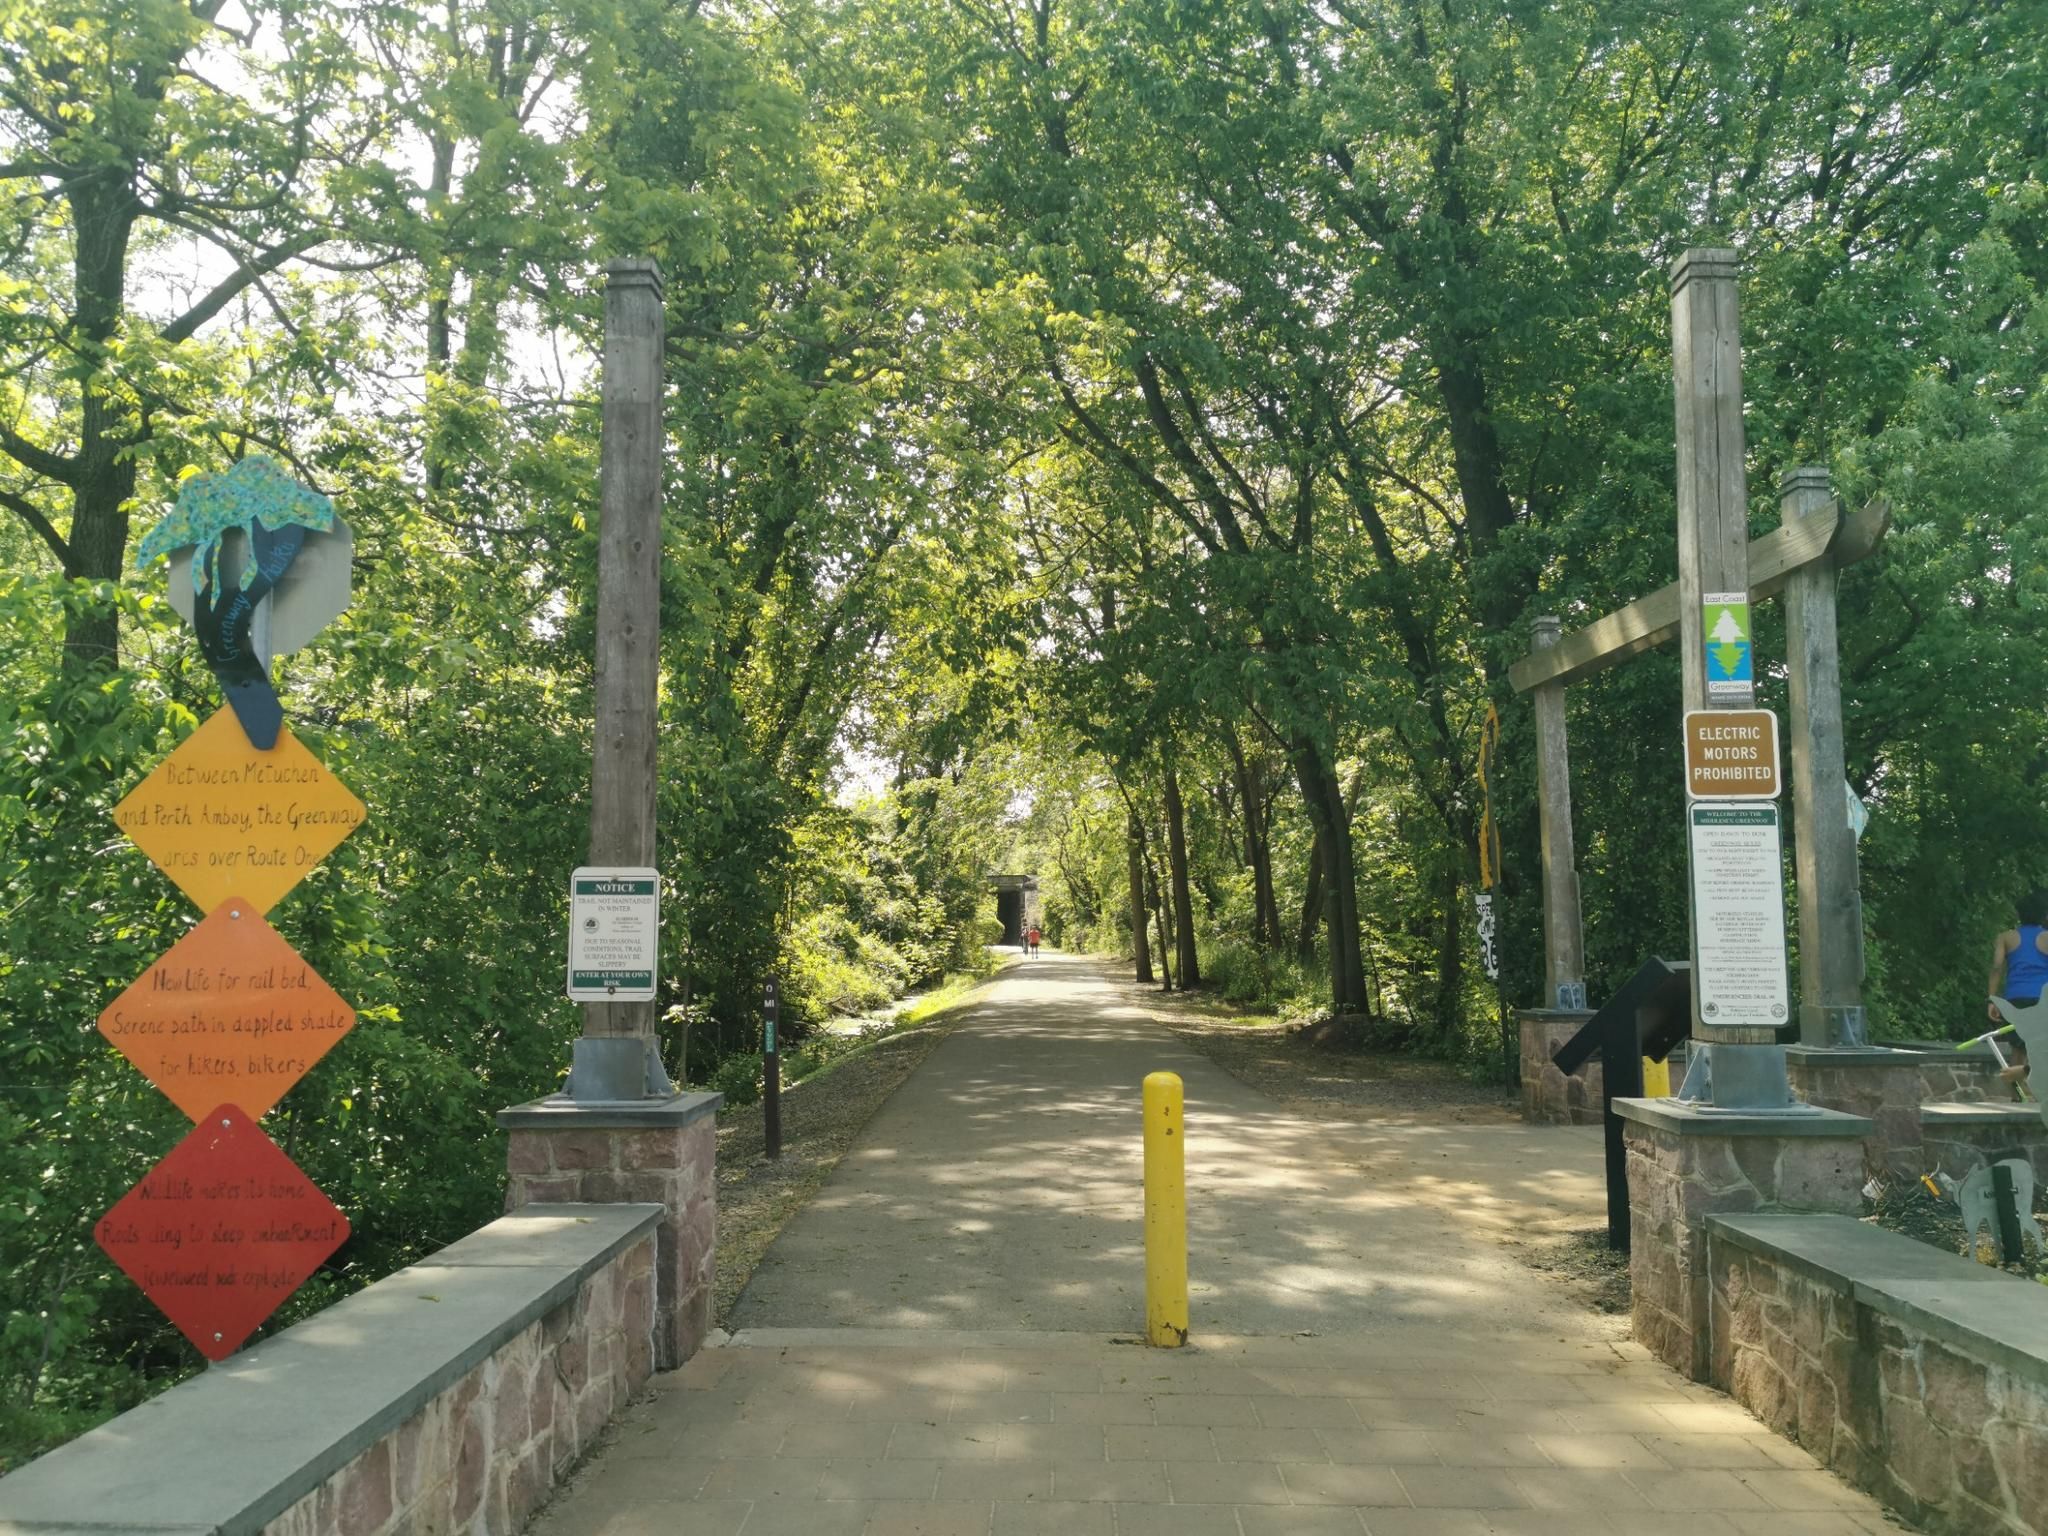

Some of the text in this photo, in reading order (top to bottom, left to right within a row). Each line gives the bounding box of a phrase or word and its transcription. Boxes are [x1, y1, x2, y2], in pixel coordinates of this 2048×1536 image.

[1710, 682, 1751, 691] Greenway
[1699, 727, 1760, 740] ELECTRIC
[1704, 747, 1757, 760] MOTORS
[167, 761, 319, 785] Between Metuchen
[1694, 767, 1771, 780] PROHIBITED
[120, 802, 360, 832] and Perth Amboy, the Greenway
[164, 851, 198, 867] arcs
[209, 851, 241, 867] over
[247, 846, 286, 866] Route
[595, 883, 635, 892] NOTICE
[218, 968, 240, 992] for
[112, 1010, 345, 1037] Serene path in dappled shade
[160, 1055, 181, 1078] for
[248, 1054, 305, 1074] bikers
